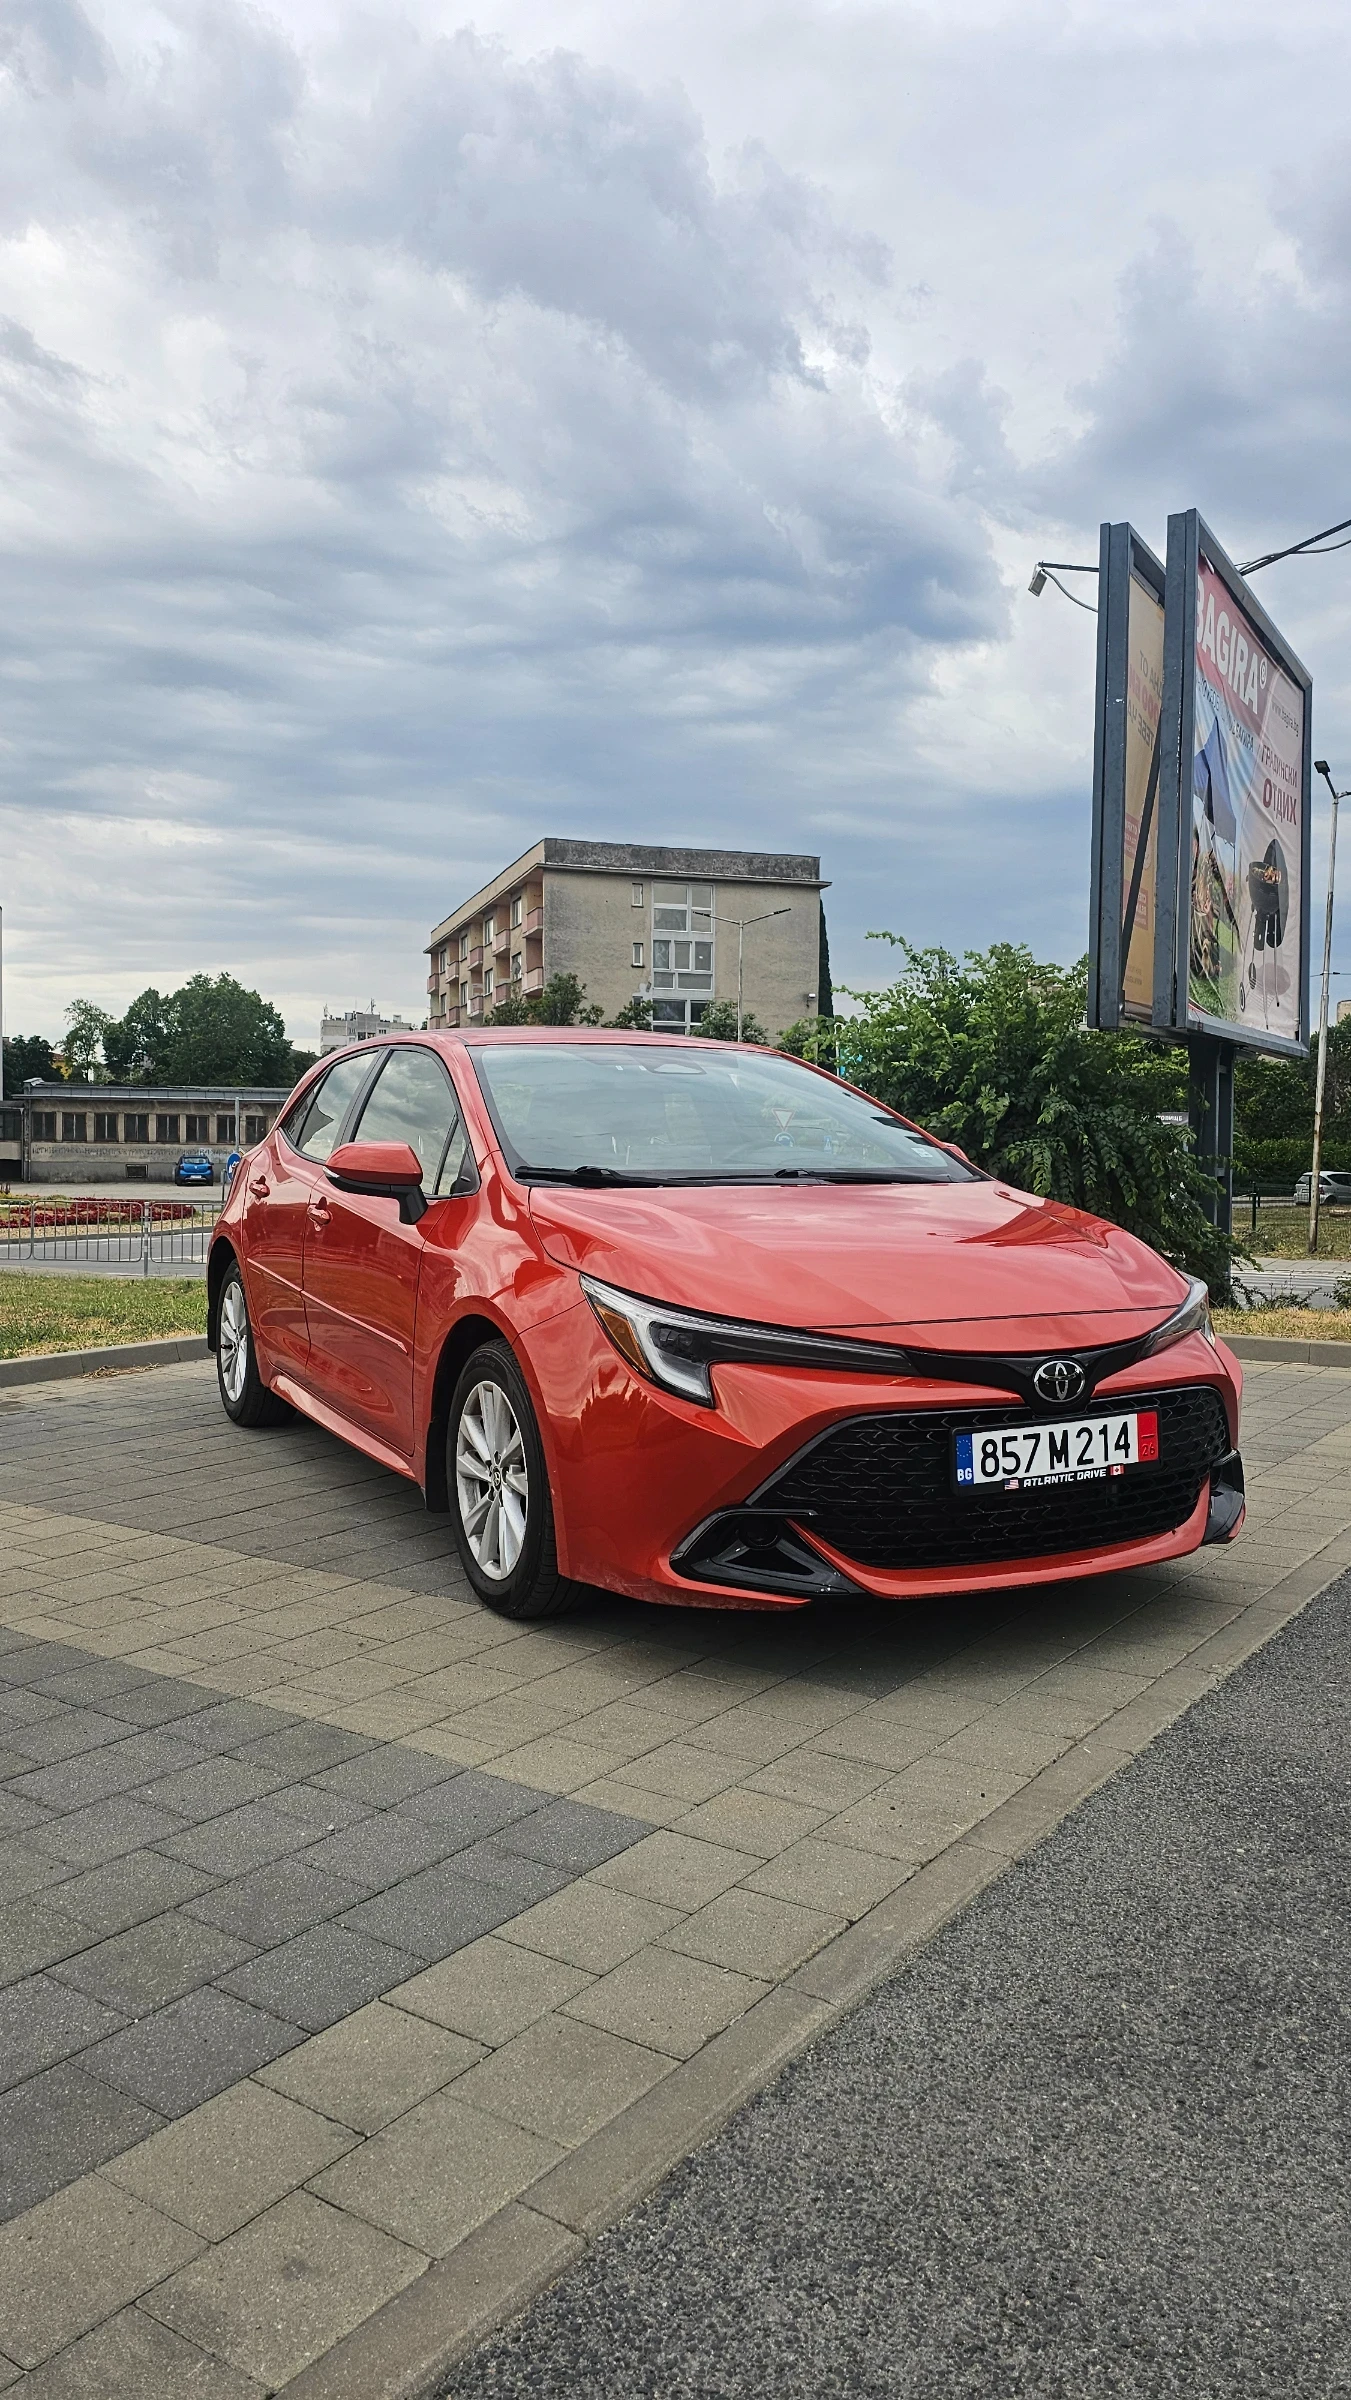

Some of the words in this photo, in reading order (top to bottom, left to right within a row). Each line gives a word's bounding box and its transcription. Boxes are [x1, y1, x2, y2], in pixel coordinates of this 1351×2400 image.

[1271, 701, 1299, 738] www.bagira.bg
[1261, 744, 1298, 788] ГРАДИНСКИ
[1262, 777, 1298, 826] ОТДИХ
[1141, 1442, 1155, 1457] 26
[957, 1468, 973, 1482] BG
[1023, 1472, 1075, 1488] ATLANTIC
[1076, 1468, 1107, 1481] DRIVE
